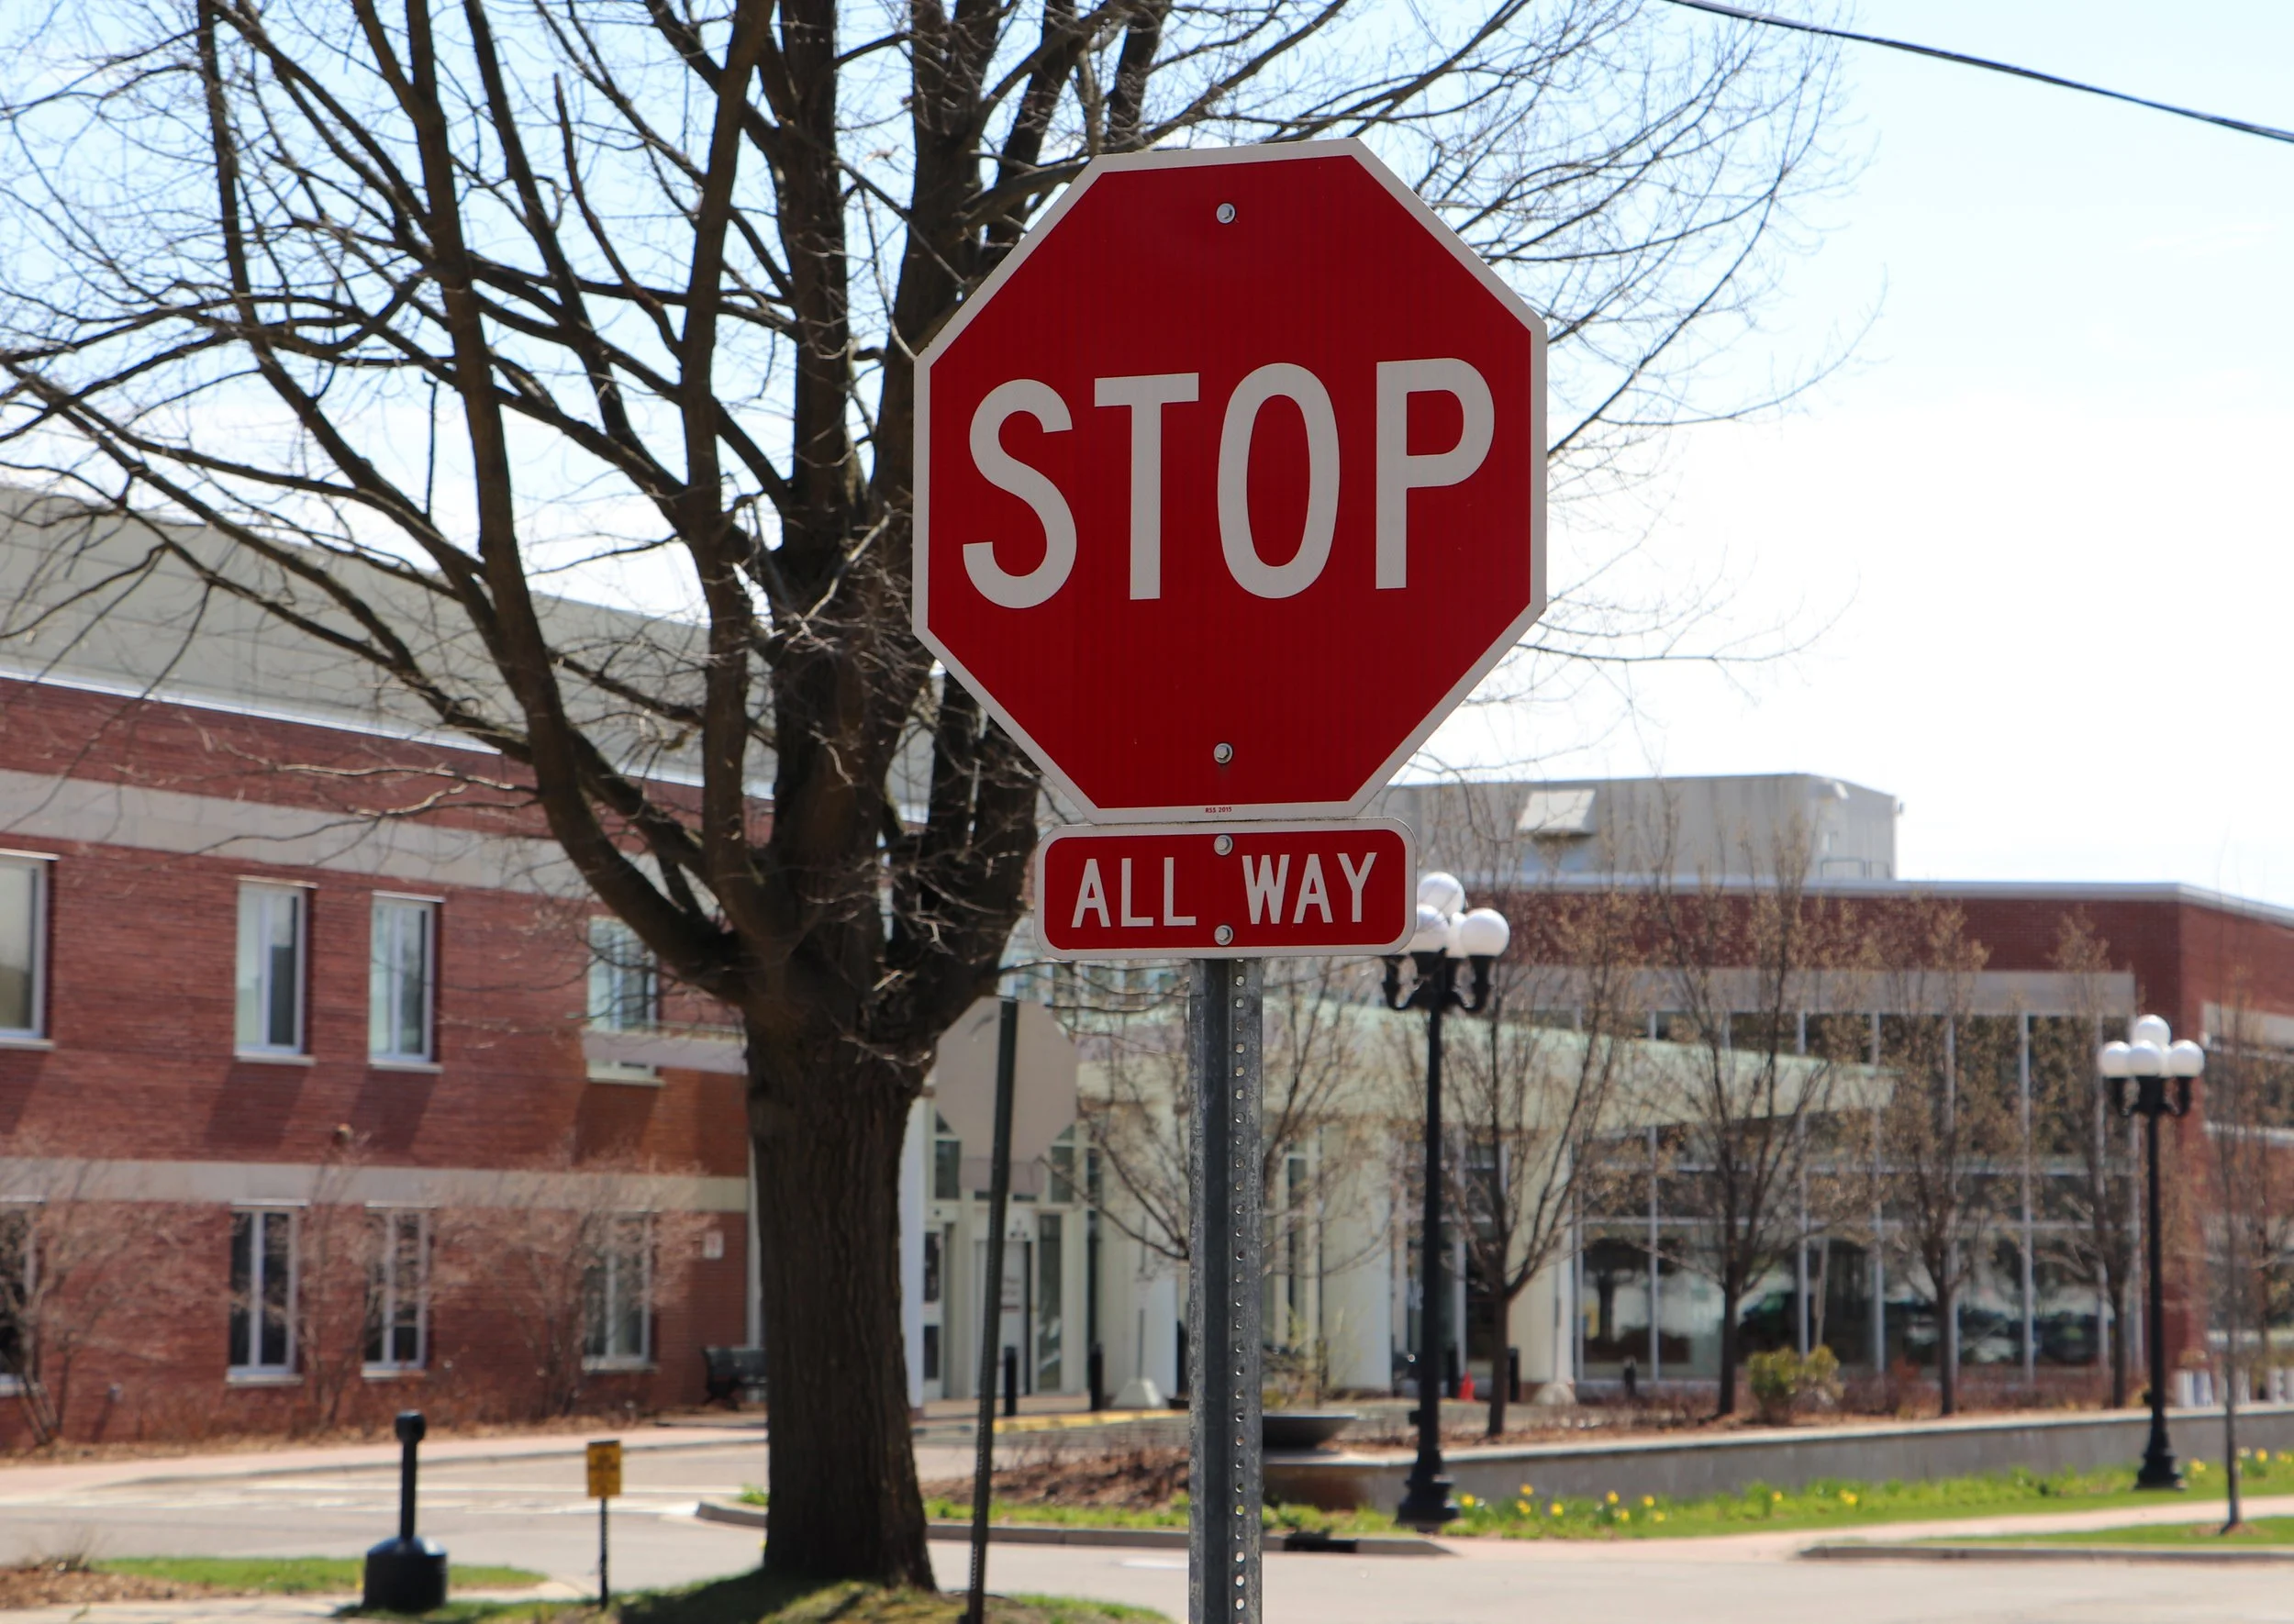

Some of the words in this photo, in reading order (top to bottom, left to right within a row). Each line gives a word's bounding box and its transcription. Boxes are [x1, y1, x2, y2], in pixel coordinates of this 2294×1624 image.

[963, 358, 1495, 609] STOP
[1072, 857, 1197, 928] ALL
[1242, 852, 1377, 925] WAY
